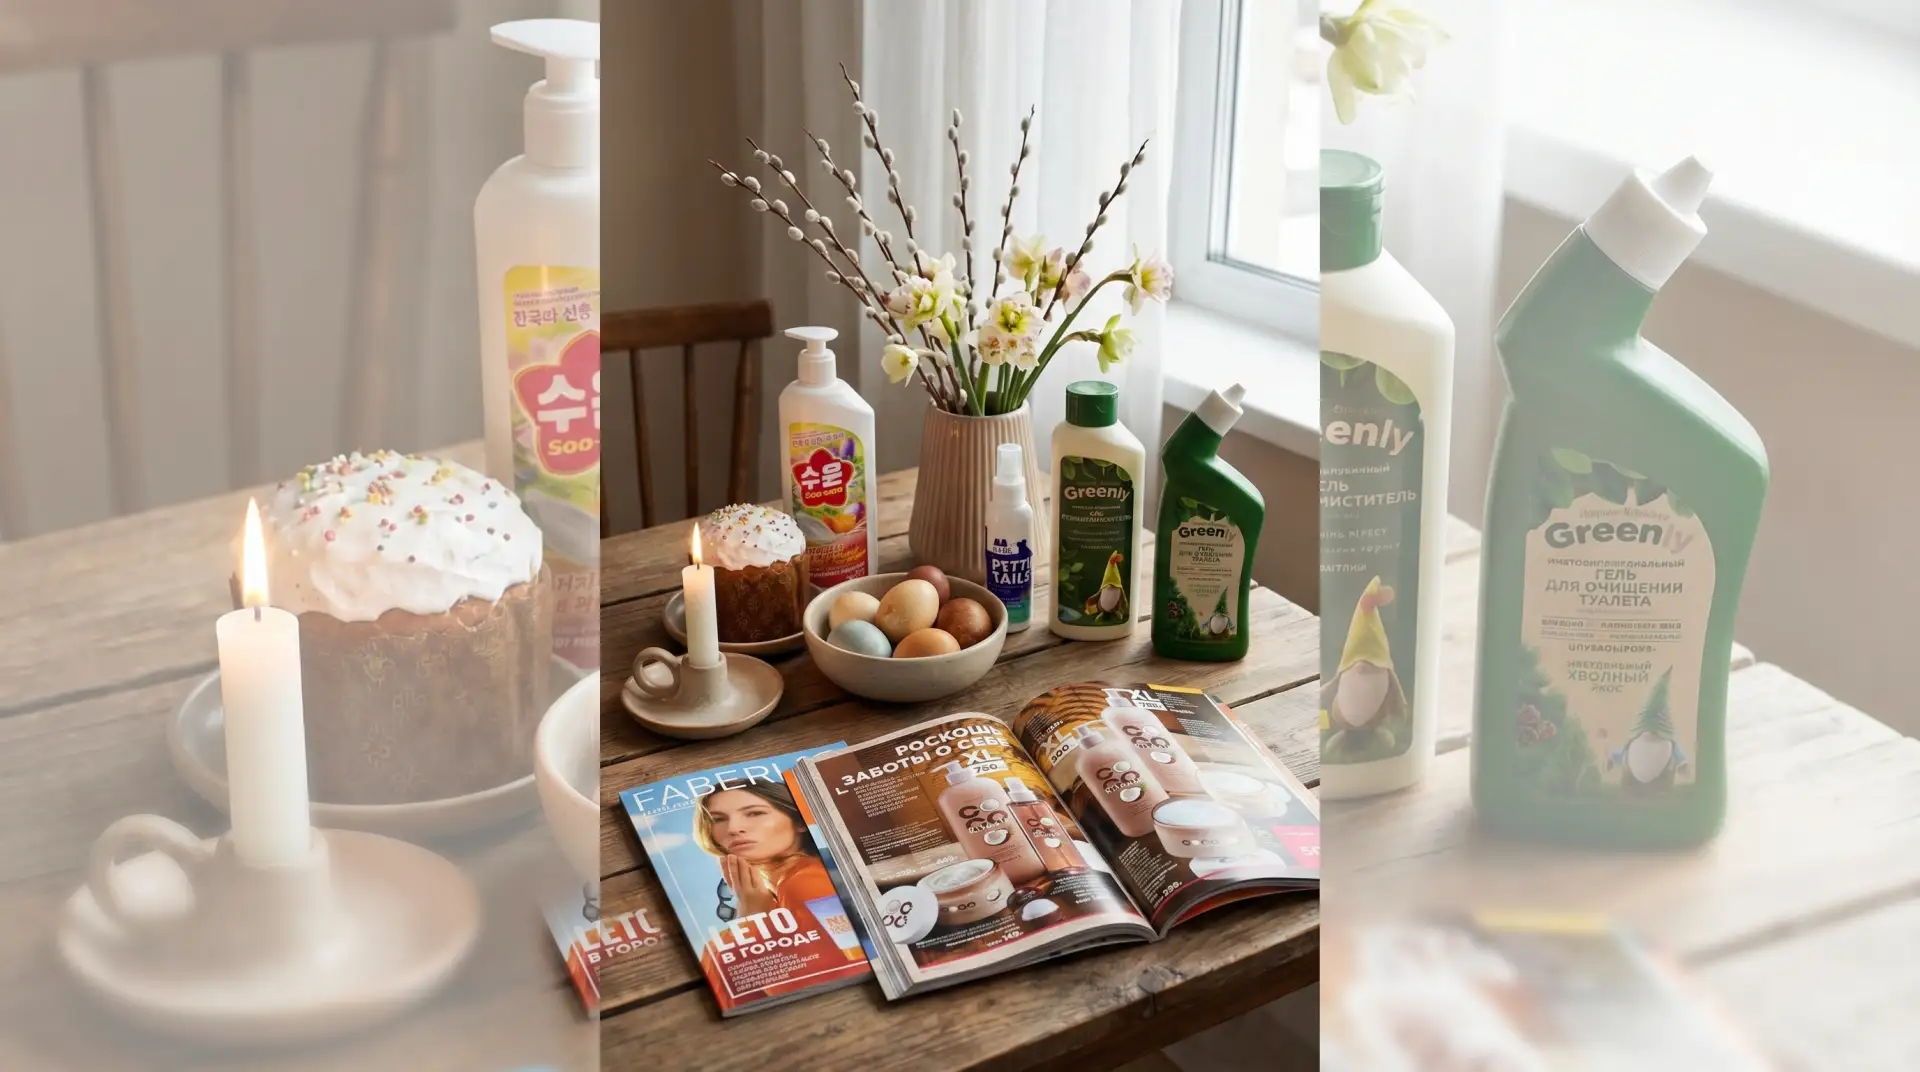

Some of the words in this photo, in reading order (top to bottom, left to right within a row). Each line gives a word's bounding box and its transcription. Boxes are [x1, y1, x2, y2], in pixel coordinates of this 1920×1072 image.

[537, 370, 600, 434] 수
[1319, 417, 1415, 456] enly
[1064, 485, 1131, 502] Greenly
[1178, 526, 1236, 541] Greenly
[1544, 521, 1694, 555] Greenly
[991, 570, 1031, 585] TAILS
[1595, 569, 1637, 580] ГЕЛЬ
[1545, 579, 1580, 594] ДЛЯ
[1579, 594, 1652, 607] ТУАЛЕТА
[841, 752, 932, 786] ЗАБОТЫ
[935, 744, 953, 758] О
[721, 951, 736, 965] В
[739, 929, 821, 958] ГОРОДЕ
